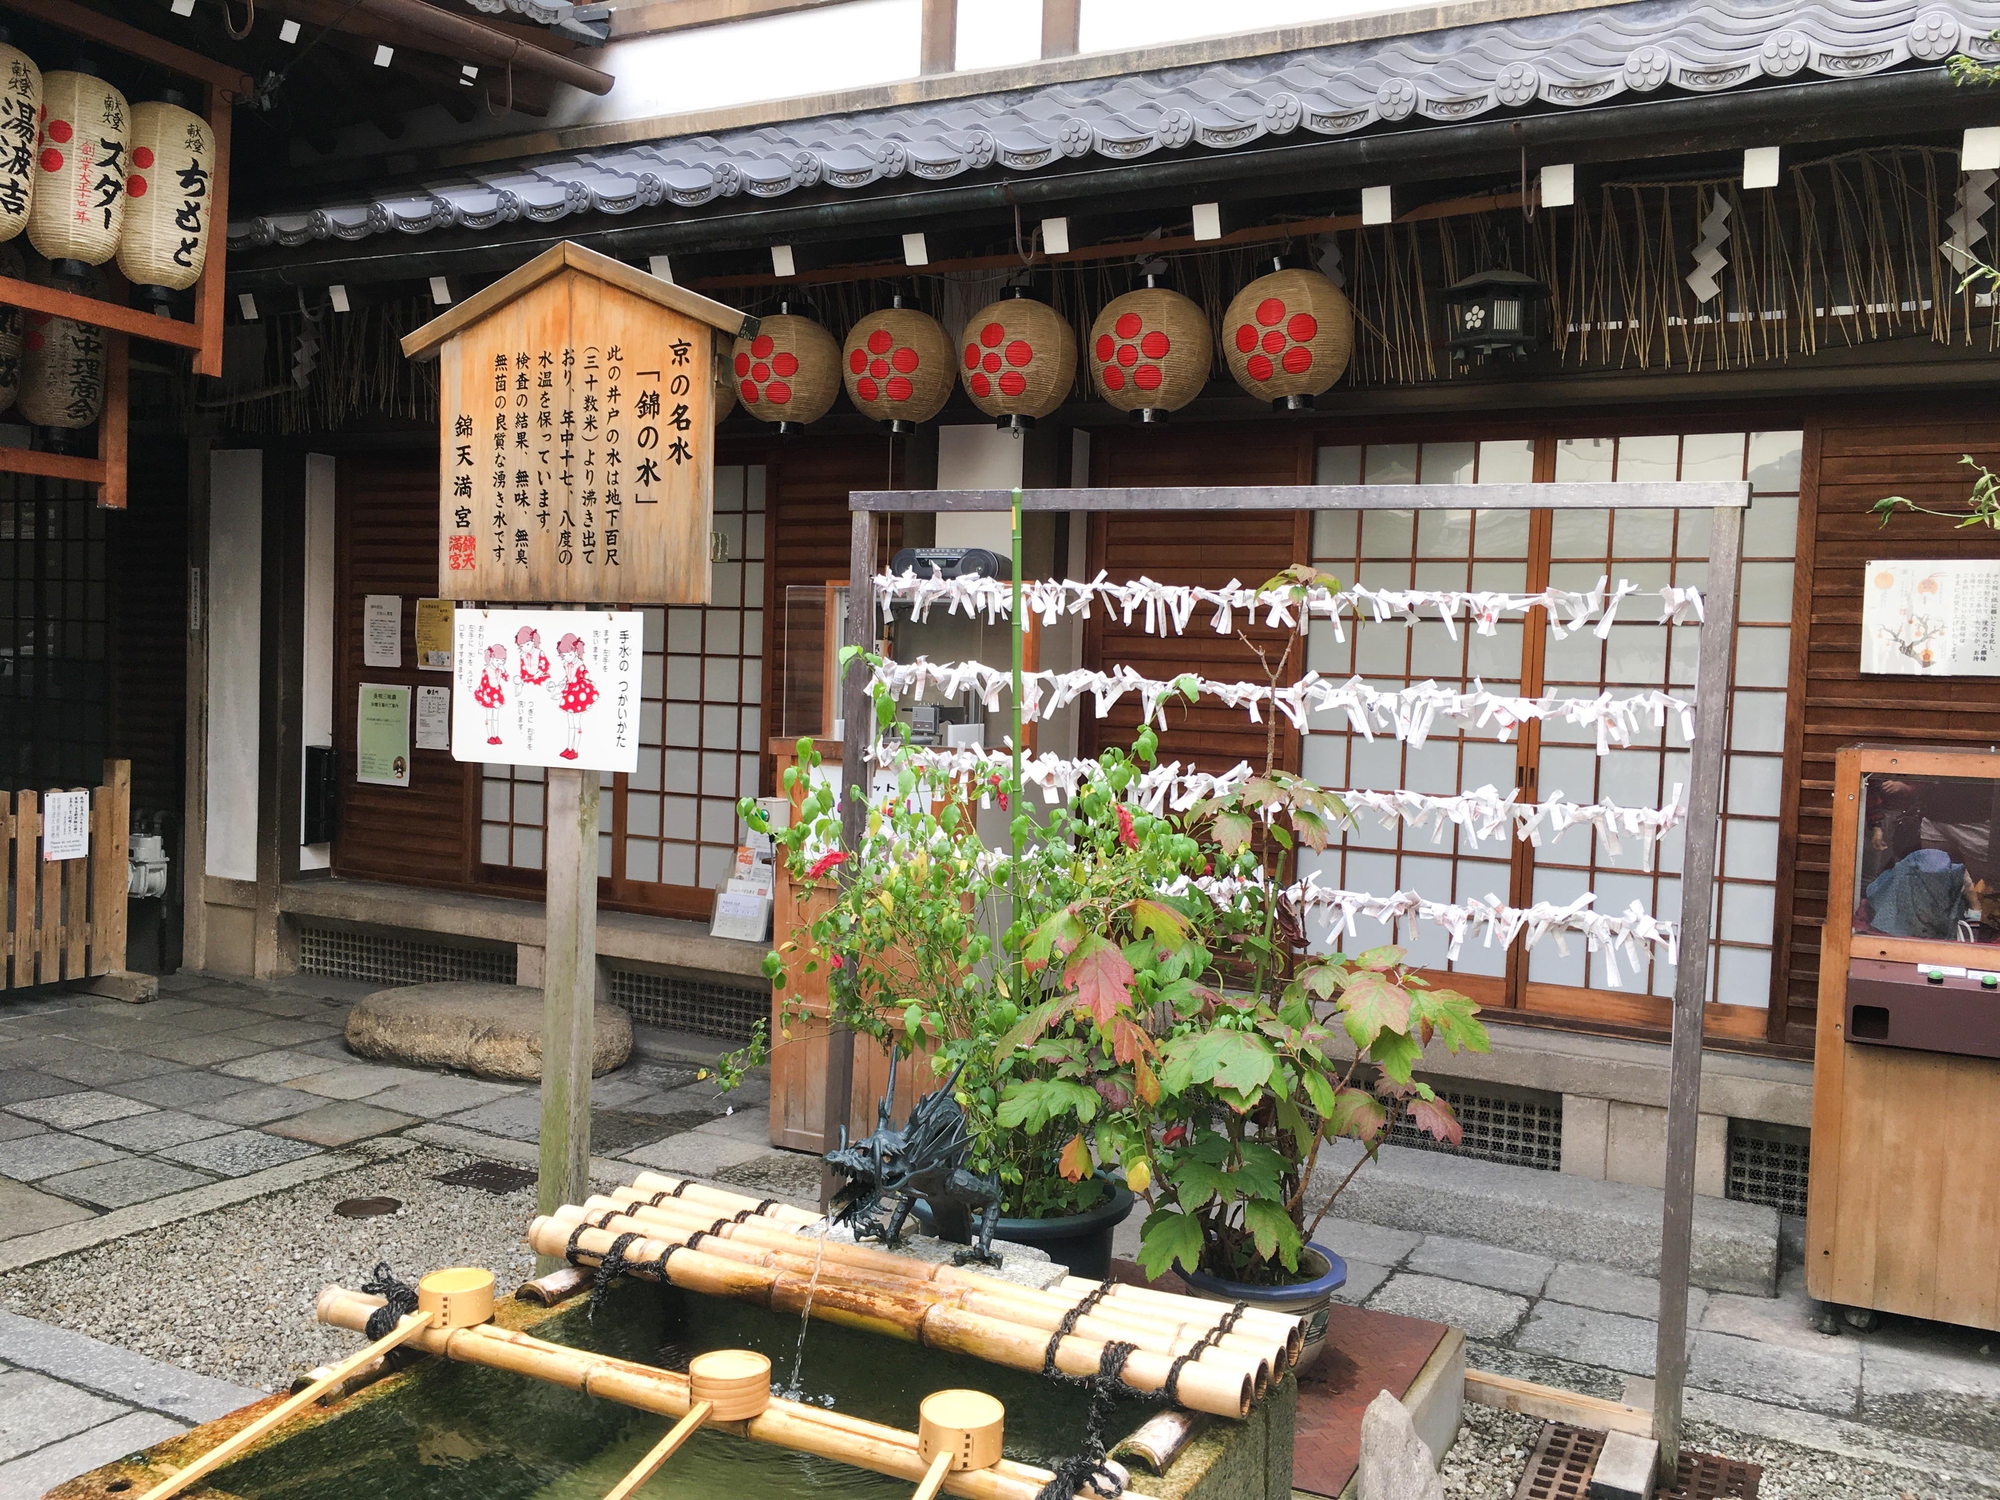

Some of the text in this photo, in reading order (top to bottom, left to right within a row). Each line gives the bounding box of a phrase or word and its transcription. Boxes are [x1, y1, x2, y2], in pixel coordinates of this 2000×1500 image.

[0, 96, 36, 216] 湯波吉
[93, 137, 124, 230] スター
[172, 158, 209, 268] ちもと
[491, 353, 509, 568] 無菌の良質な湧き水です。
[536, 350, 554, 535] 水温を保っています。
[604, 344, 624, 567] 此の井戸の水は地下百尺
[634, 369, 662, 506] 「錦の水」
[665, 337, 694, 466] 京の名水
[453, 413, 475, 529] 錦天満宮
[615, 629, 630, 748] 手水の つかいかた
